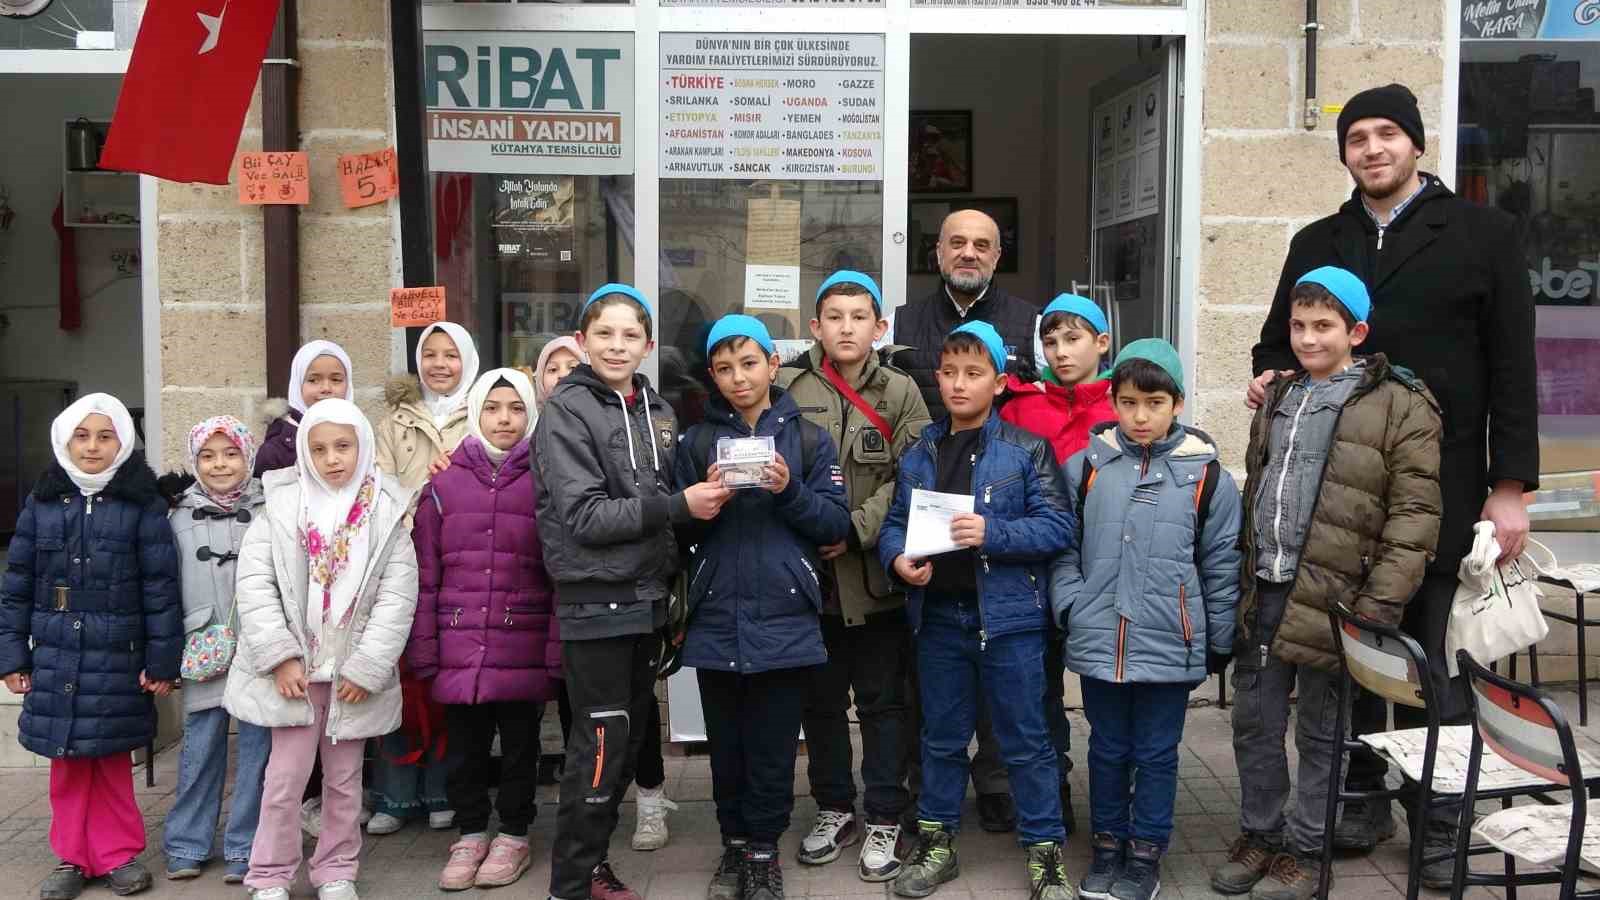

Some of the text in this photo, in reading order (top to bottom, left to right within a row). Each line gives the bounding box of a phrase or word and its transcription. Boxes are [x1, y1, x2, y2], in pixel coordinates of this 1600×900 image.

[1480, 13, 1524, 37] KARA
[696, 37, 850, 52] DÜNYA'NIN BİR ÇOK ÜLKESİNDE
[665, 54, 705, 65] YARDIM
[672, 74, 724, 89] TÜRKİYE
[787, 79, 816, 89] MORO
[843, 79, 875, 89] GAZZE
[669, 95, 719, 105] SRILANKA
[734, 94, 771, 106] SOMALİ
[786, 97, 828, 106] UGANDA
[842, 97, 876, 107] SUDAN
[734, 113, 761, 123] MISIR
[787, 113, 821, 123] YEMEN
[432, 114, 614, 142] İNSANİ YARDIM
[756, 129, 780, 139] ADALARI
[491, 143, 621, 156] KÜTAHYA TEMSİLCİLİĞİ
[669, 146, 693, 156] ARAKAN
[694, 146, 724, 156] KAMPLARI
[786, 147, 834, 158] MAKEDONYA
[842, 148, 872, 158] KOSOVA
[669, 162, 724, 173] ARNAVUTLUK
[733, 162, 770, 173] SANCAK
